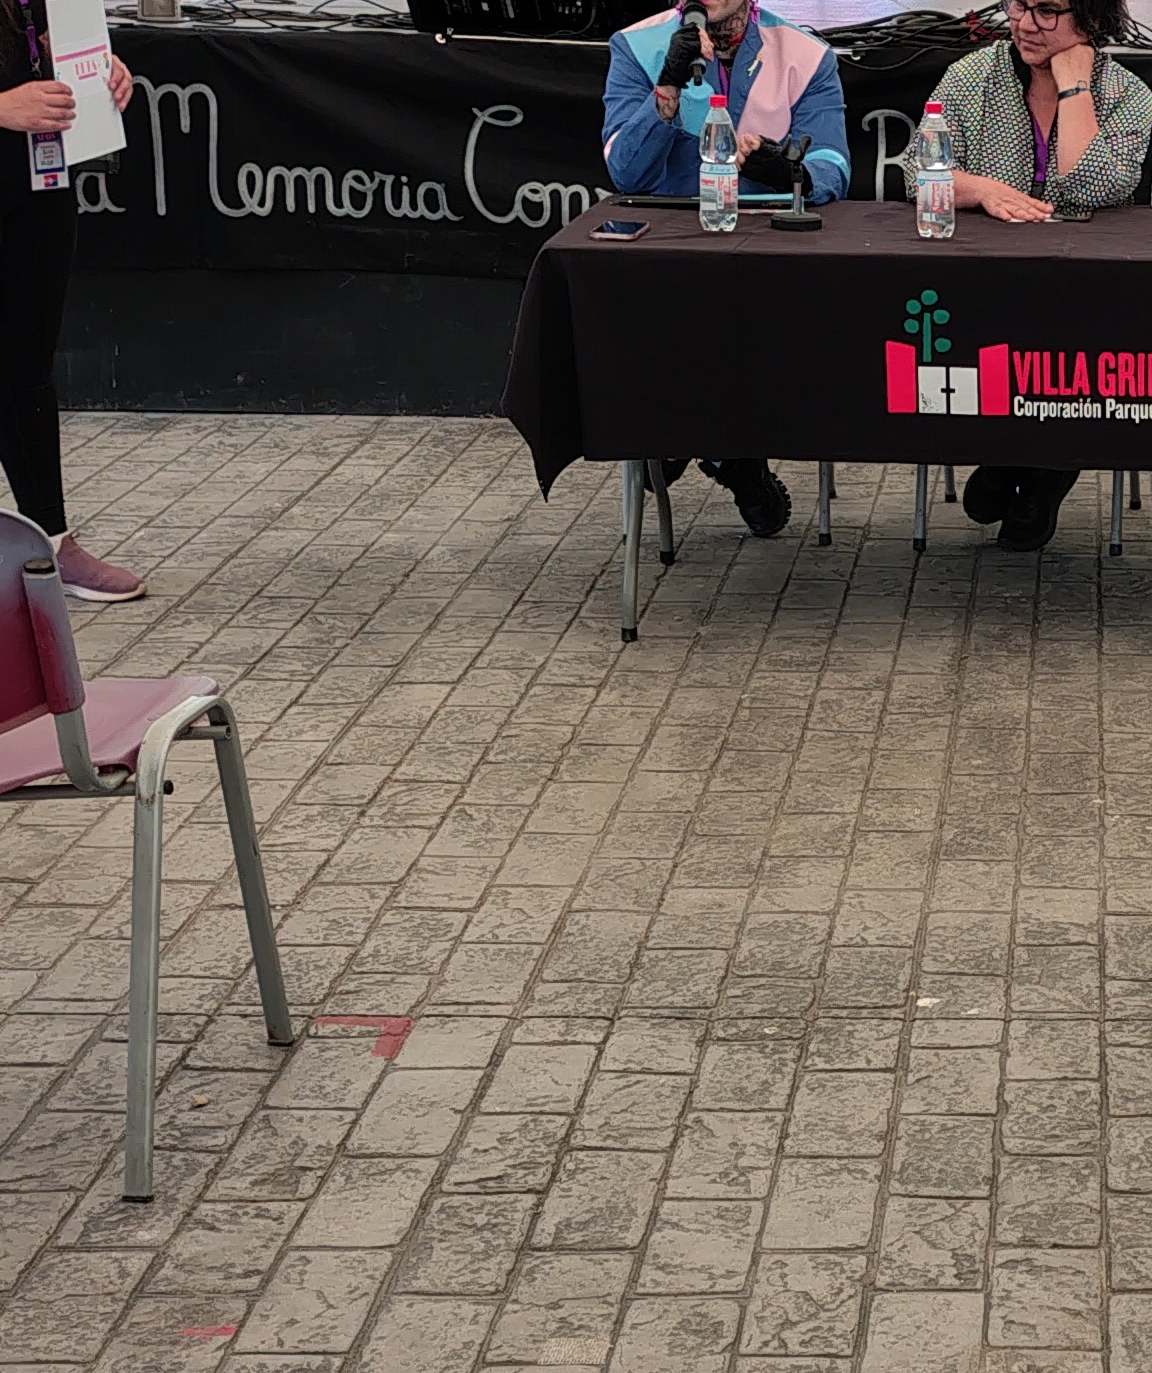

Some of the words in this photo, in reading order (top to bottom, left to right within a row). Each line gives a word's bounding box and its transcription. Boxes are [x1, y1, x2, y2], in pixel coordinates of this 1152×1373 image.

[131, 75, 464, 222] Memoria
[1012, 351, 1091, 396] VILLA
[1013, 396, 1101, 421] Corporación
